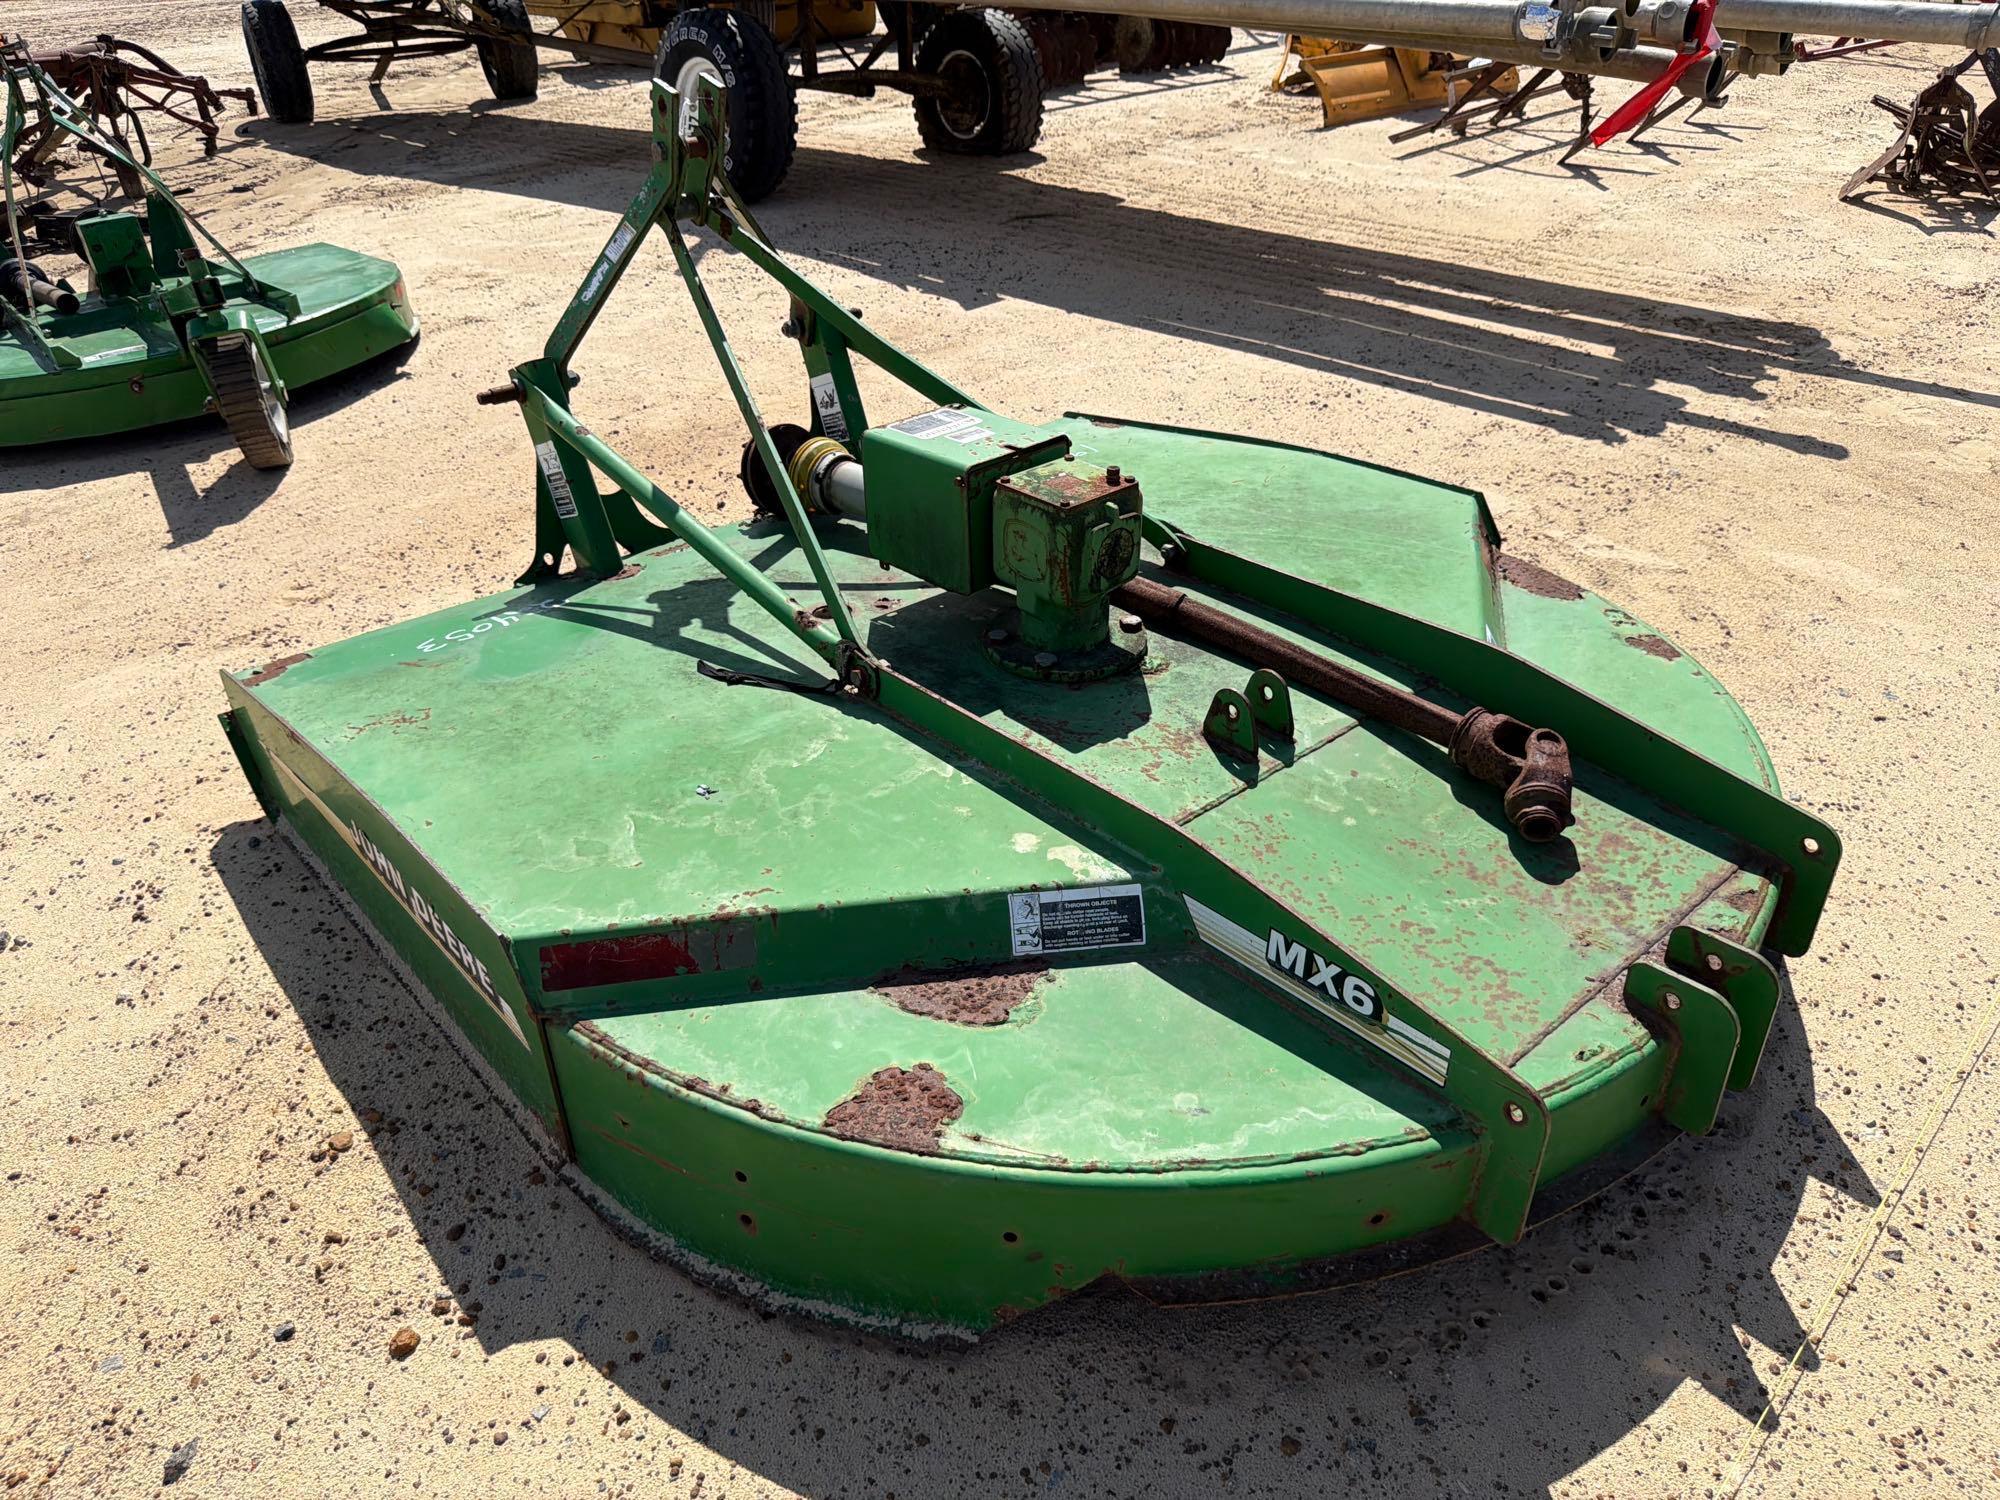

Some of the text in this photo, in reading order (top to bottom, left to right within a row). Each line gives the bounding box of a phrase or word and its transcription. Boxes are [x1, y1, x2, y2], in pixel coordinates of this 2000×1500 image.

[350, 819, 495, 997] JOHN DEERE
[1267, 928, 1375, 1016] MX6
